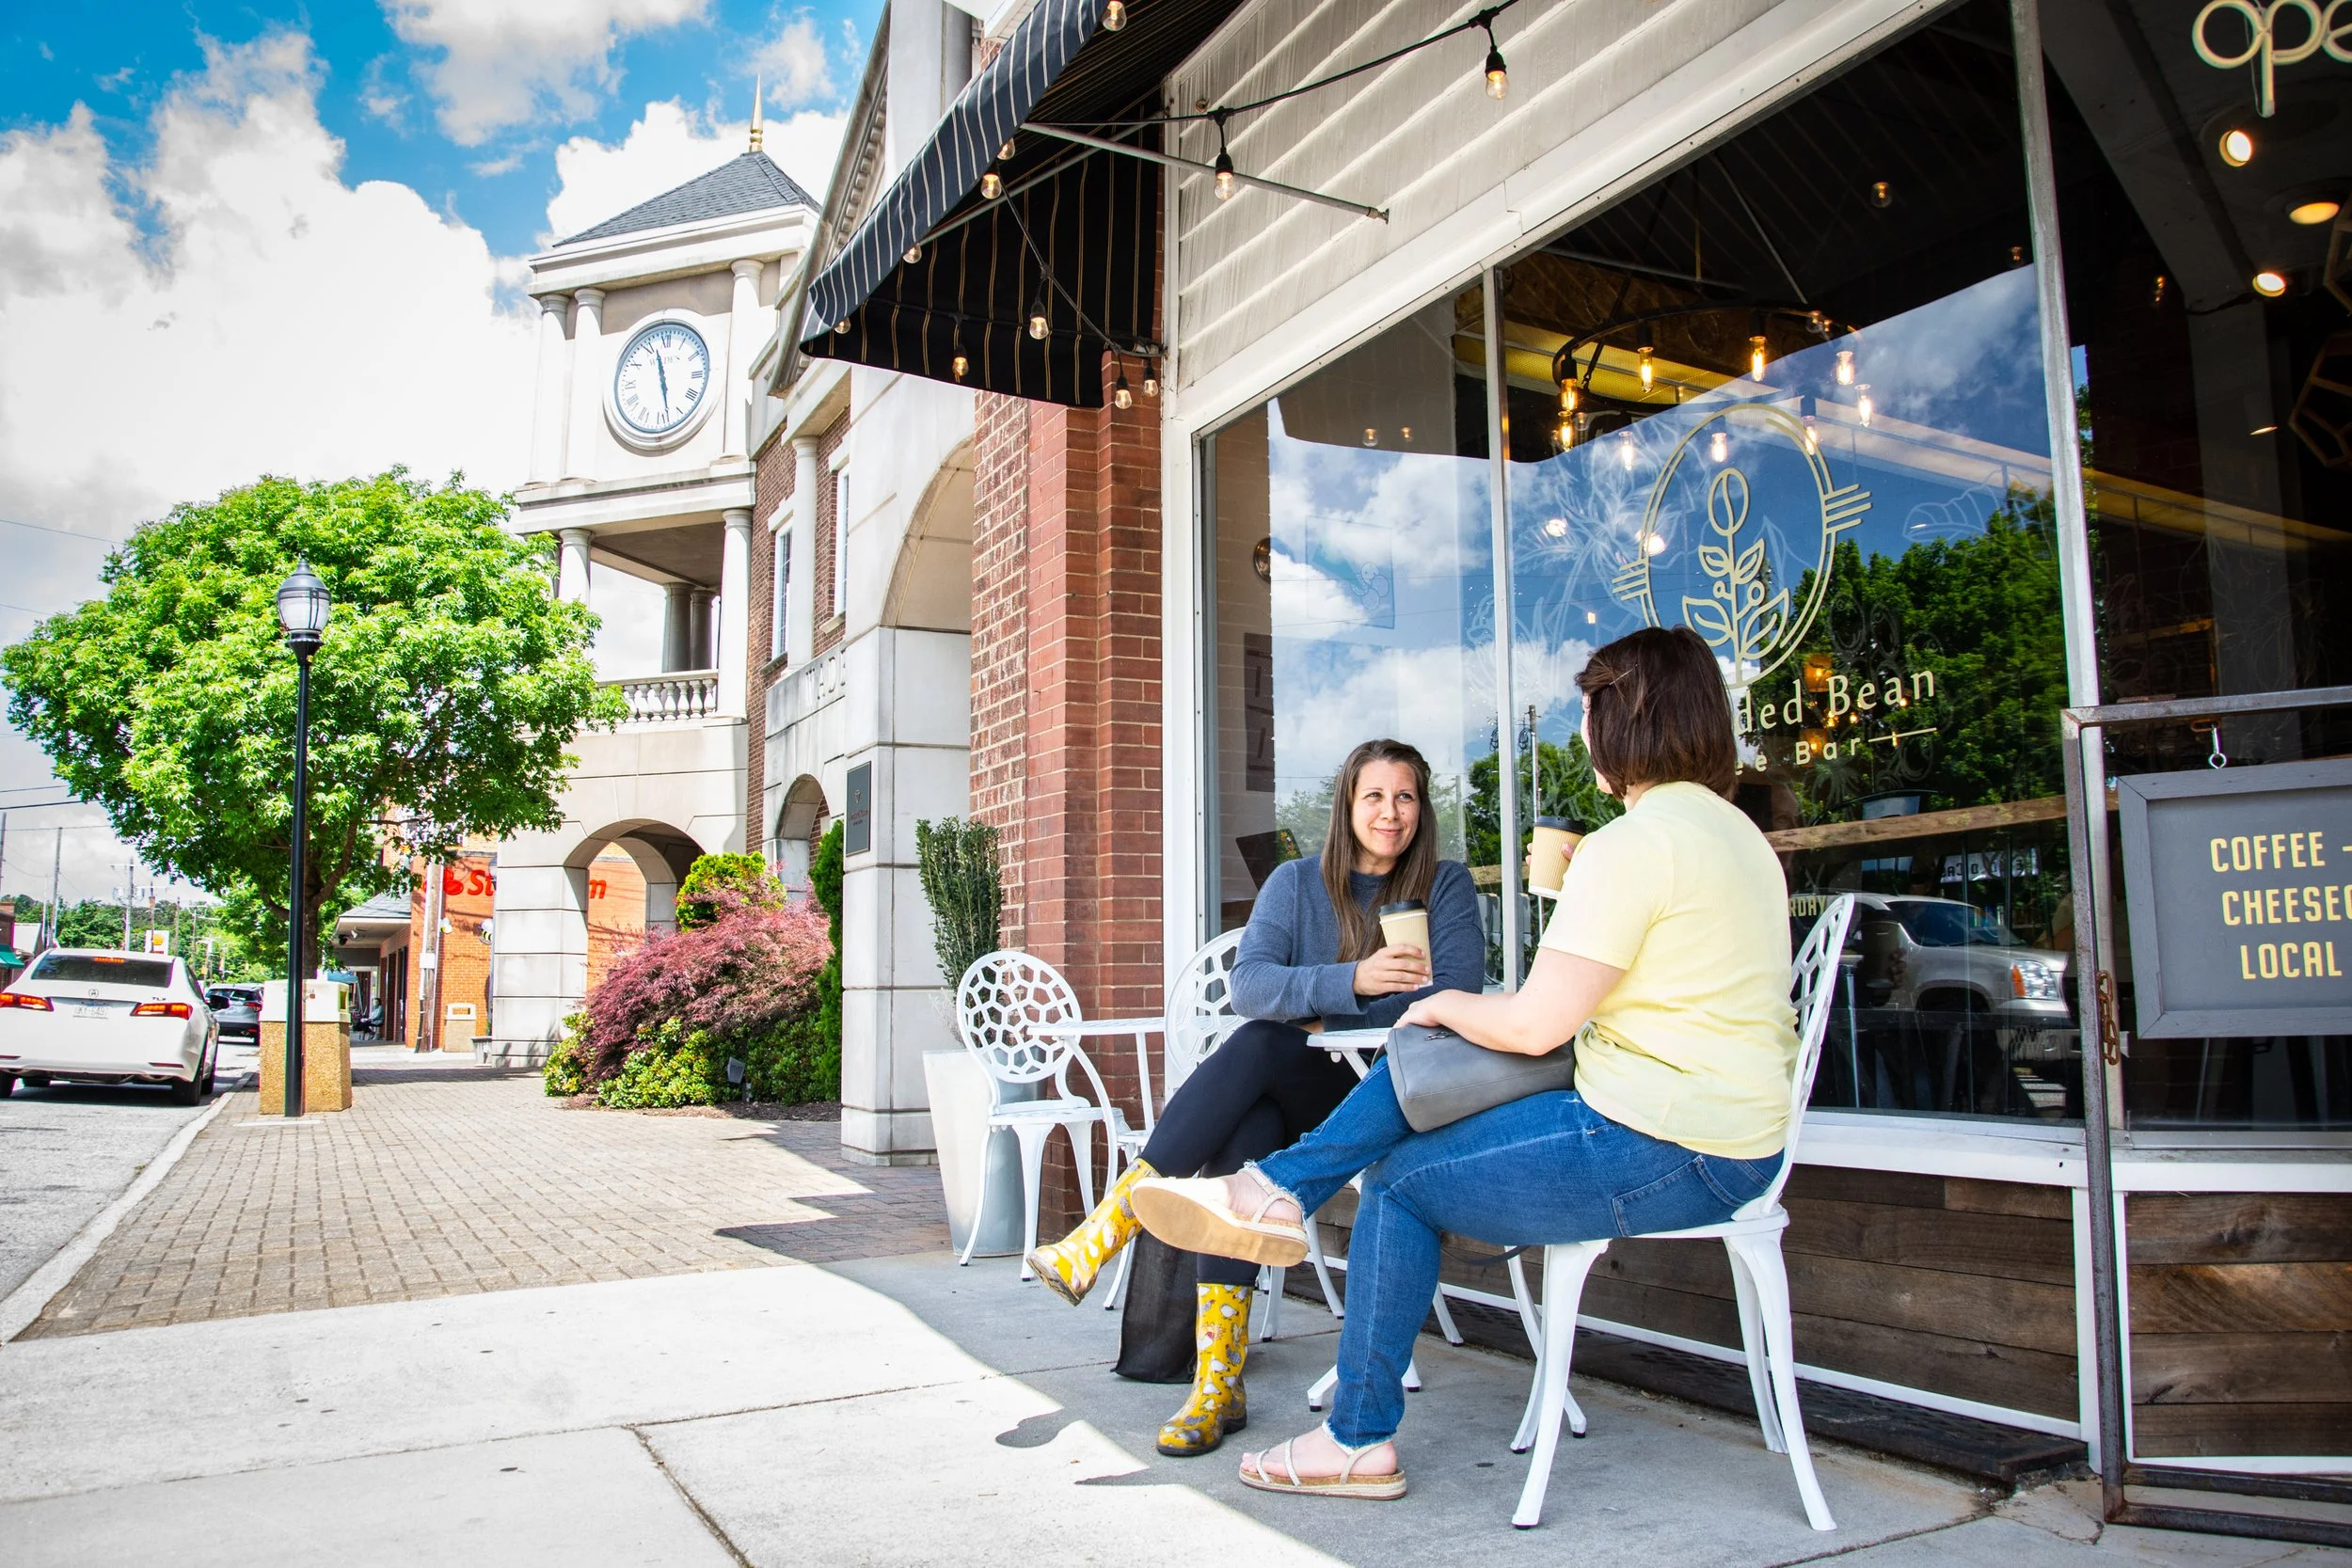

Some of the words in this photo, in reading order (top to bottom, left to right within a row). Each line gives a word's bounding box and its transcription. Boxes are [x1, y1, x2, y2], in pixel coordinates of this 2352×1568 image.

[1735, 679, 1803, 736] ded
[1826, 671, 1934, 716] Bean
[1796, 737, 1860, 765] Bar
[2211, 832, 2326, 872] COFFEE
[1788, 895, 1826, 917] RDAY
[2240, 942, 2343, 979] LOCAL
